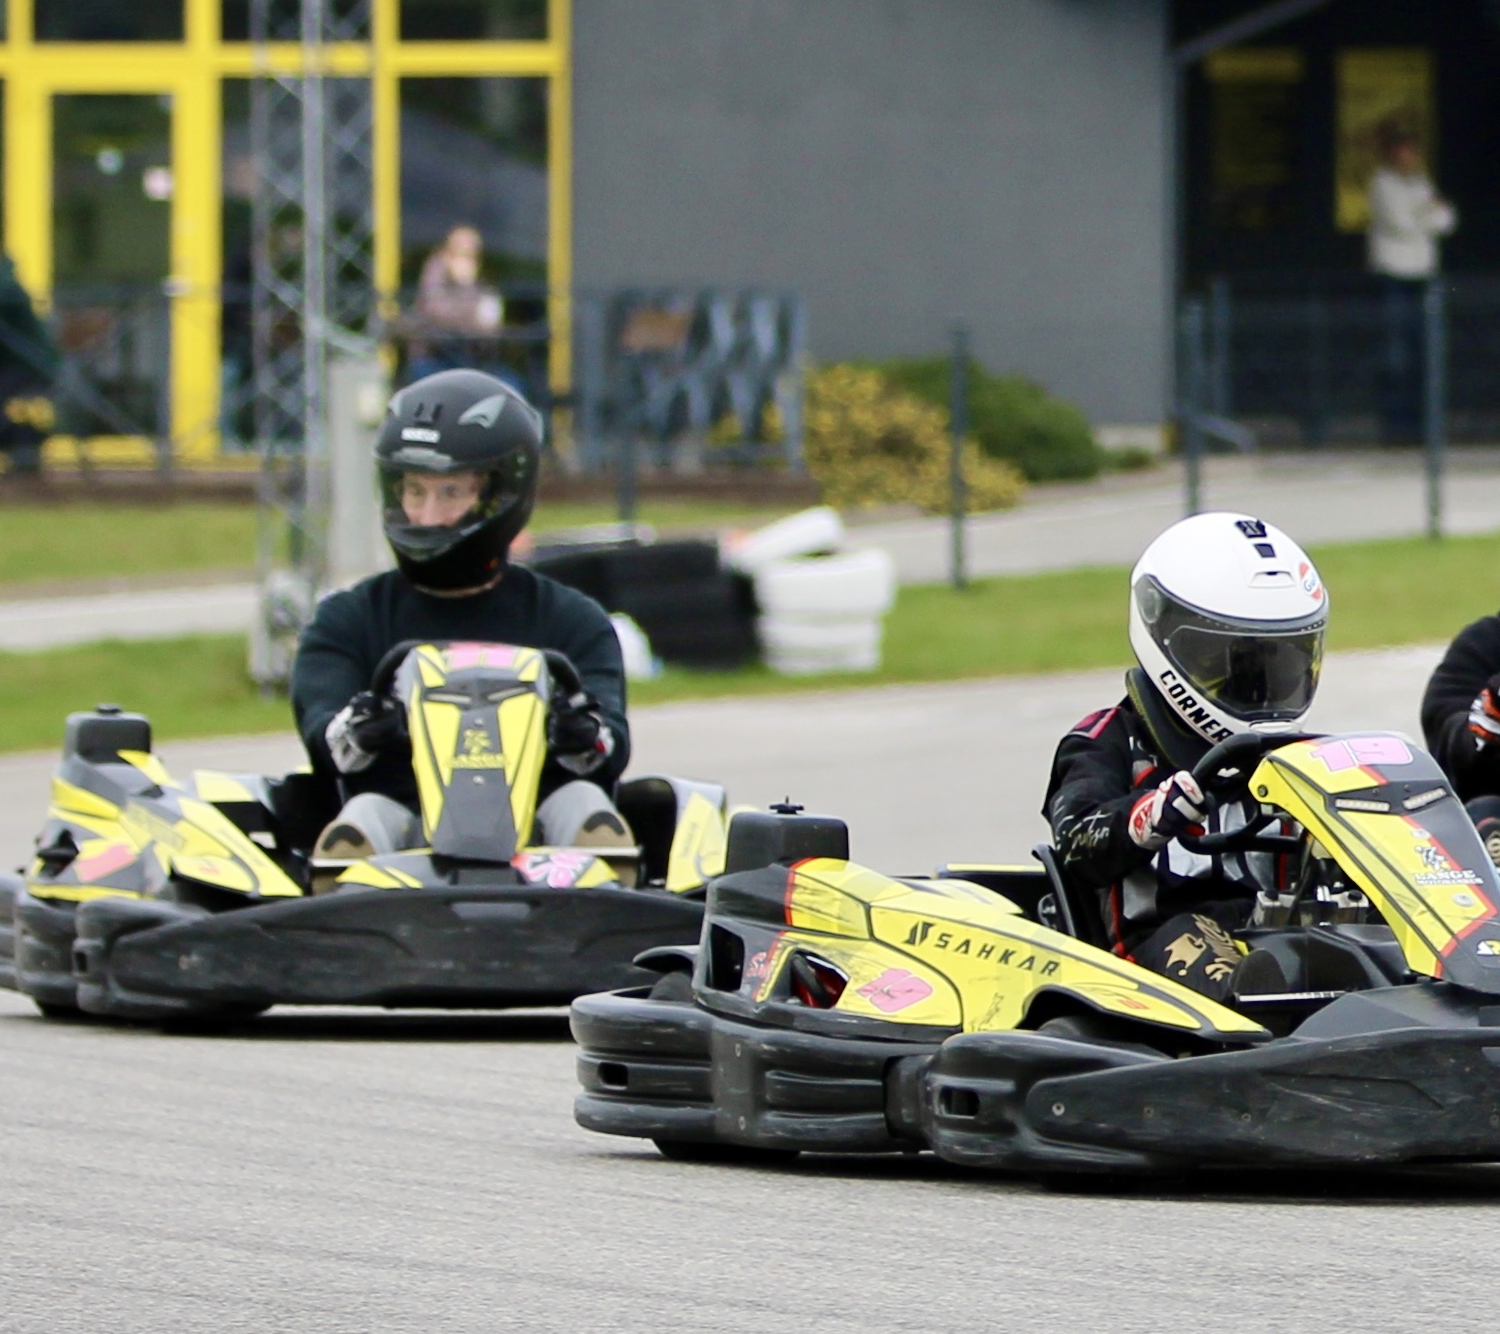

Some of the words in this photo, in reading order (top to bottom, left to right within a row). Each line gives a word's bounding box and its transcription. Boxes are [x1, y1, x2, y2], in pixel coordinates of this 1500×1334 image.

[1160, 669, 1235, 743] CORNER
[1308, 736, 1414, 773] 19
[1414, 870, 1476, 880] LANGE
[934, 933, 1060, 976] SAHKAR
[855, 967, 934, 1013] 19
